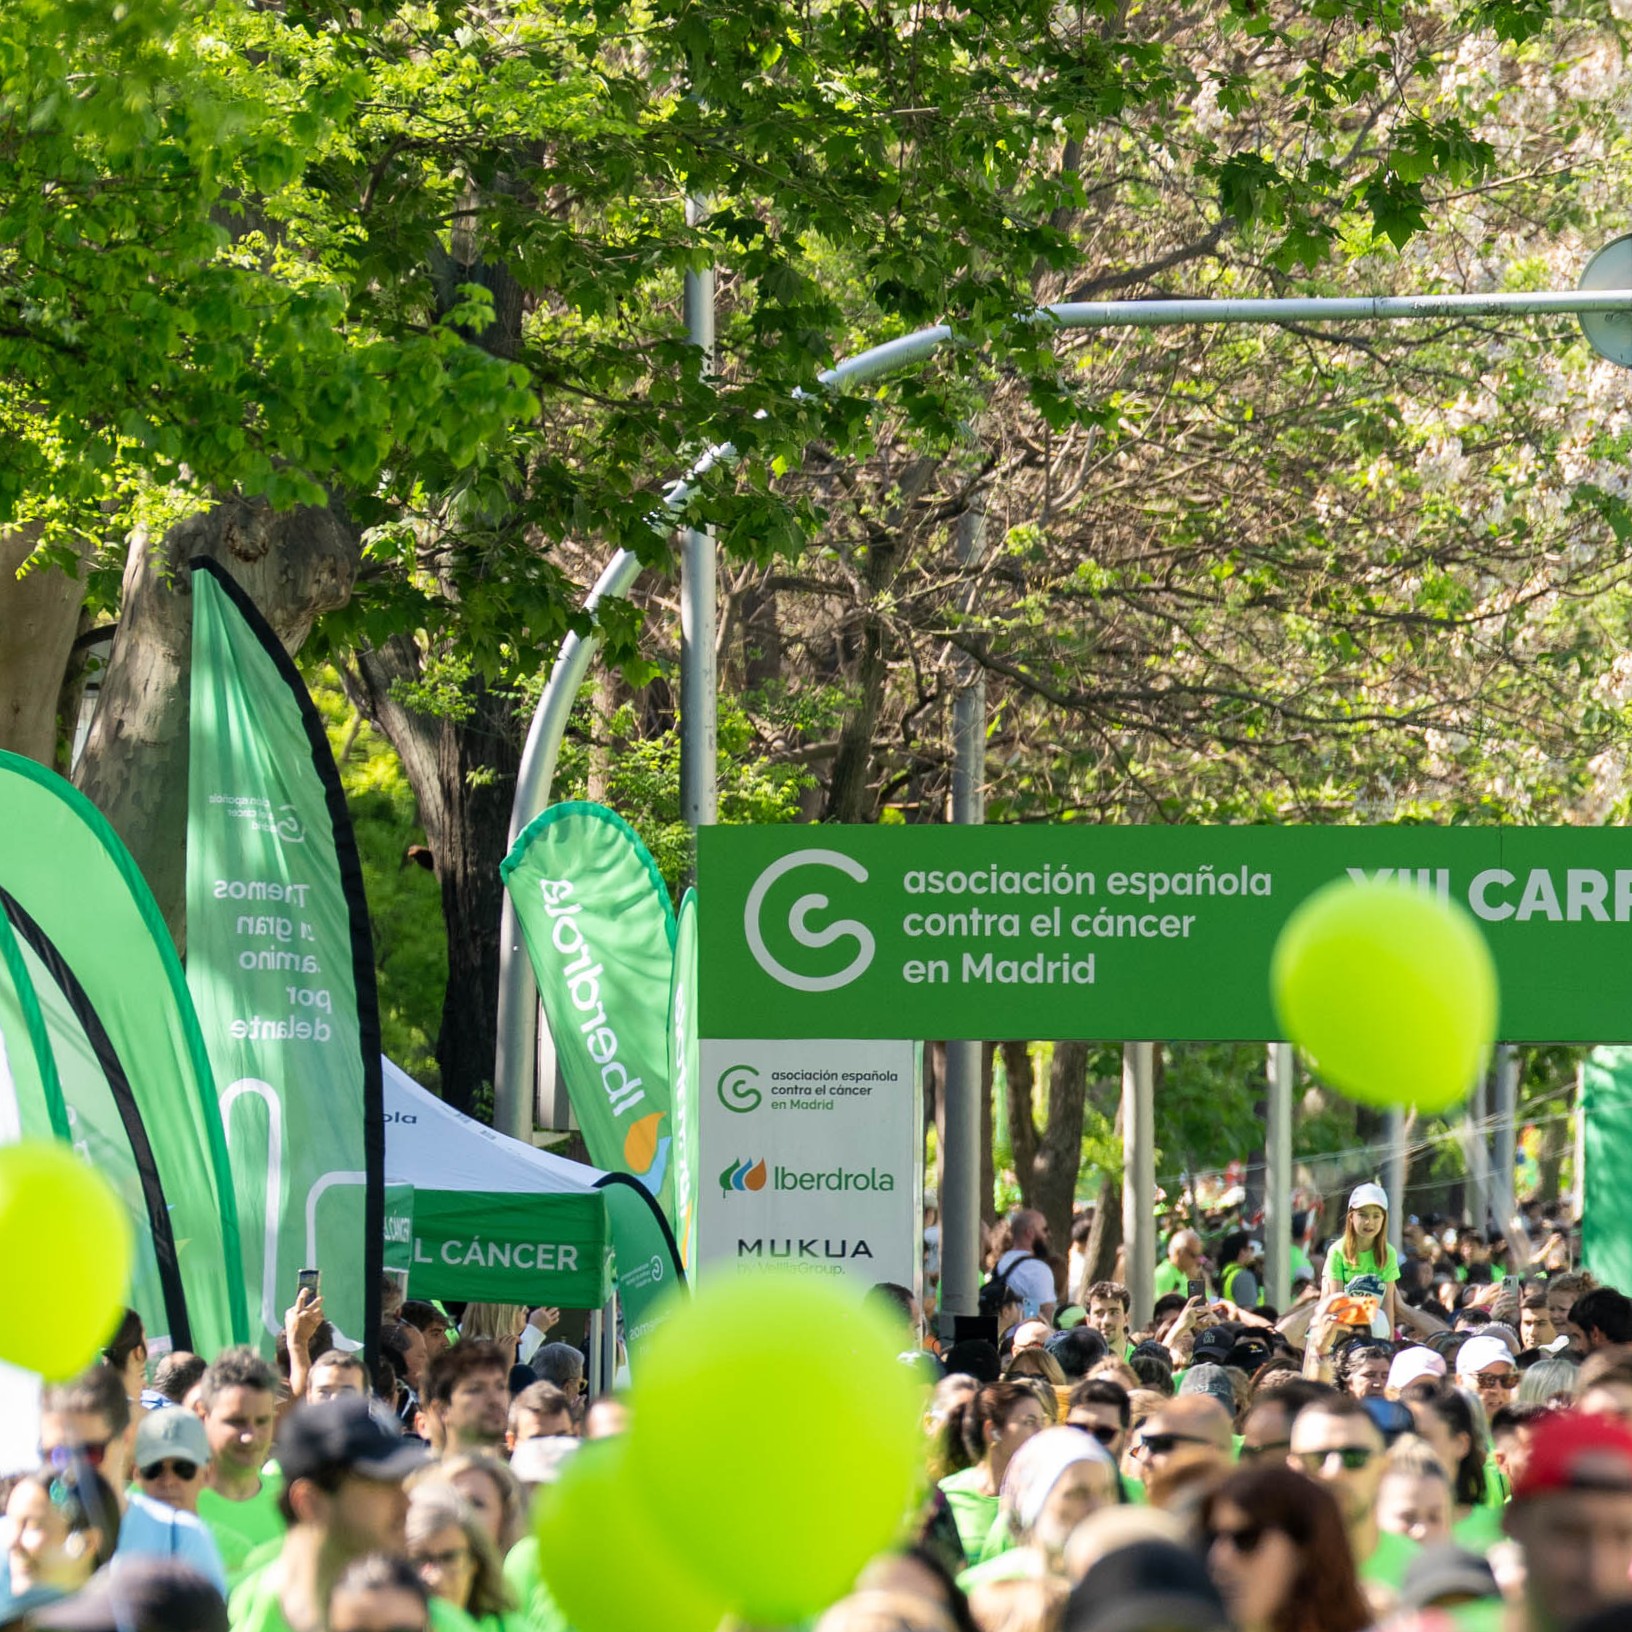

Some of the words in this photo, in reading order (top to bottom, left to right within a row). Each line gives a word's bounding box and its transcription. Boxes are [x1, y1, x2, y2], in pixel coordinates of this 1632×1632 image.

[904, 864, 1095, 894] asociación
[1107, 865, 1271, 903] española
[903, 908, 1019, 936] contra
[1031, 907, 1060, 936] el
[1071, 907, 1195, 937] cáncer
[903, 961, 948, 983] en
[963, 953, 1094, 983] Madrid
[772, 1070, 838, 1081] asociación
[842, 1070, 898, 1083] española
[771, 1085, 811, 1095] contra
[815, 1085, 826, 1095] el
[830, 1085, 872, 1096] cáncer
[771, 1101, 786, 1110] en
[791, 1099, 834, 1110] Madrid
[774, 1166, 894, 1191] Iberdrola
[441, 1235, 578, 1272] CÁNCER
[738, 1239, 873, 1258] MUKUA
